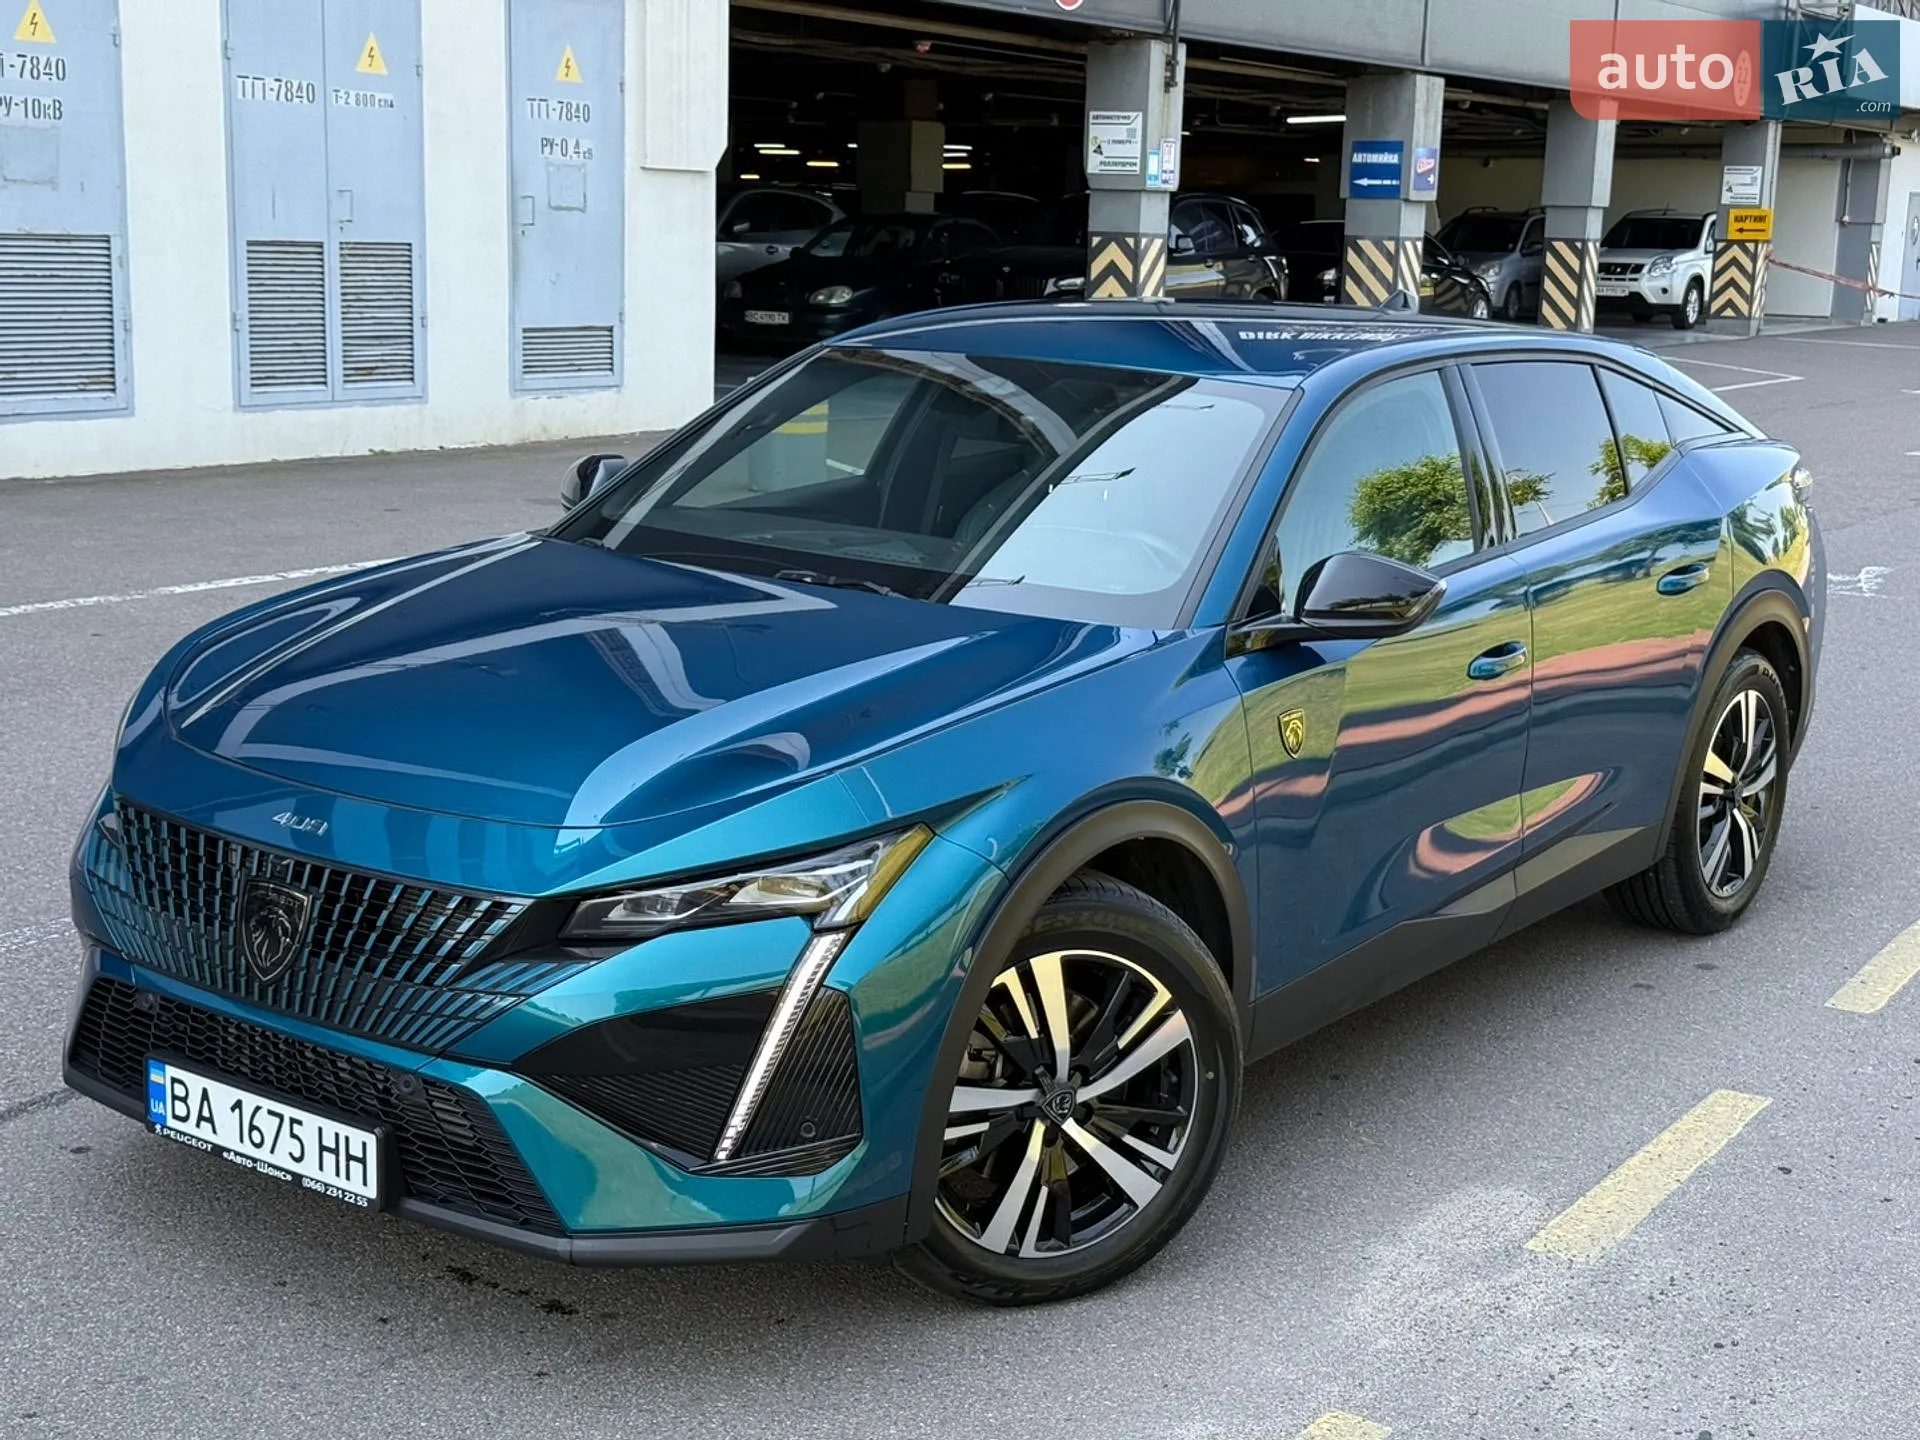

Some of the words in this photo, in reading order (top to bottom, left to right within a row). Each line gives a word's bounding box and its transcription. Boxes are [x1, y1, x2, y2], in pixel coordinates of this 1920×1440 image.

[236, 74, 316, 105] ТП-7840
[526, 97, 591, 124] ТП-7840
[1733, 214, 1768, 224] КАРТИНГ
[150, 1100, 166, 1116] UA
[162, 1127, 214, 1153] PEUGEOT
[170, 1075, 218, 1136] BA
[230, 1098, 305, 1164] 1675
[317, 1125, 368, 1188] HH
